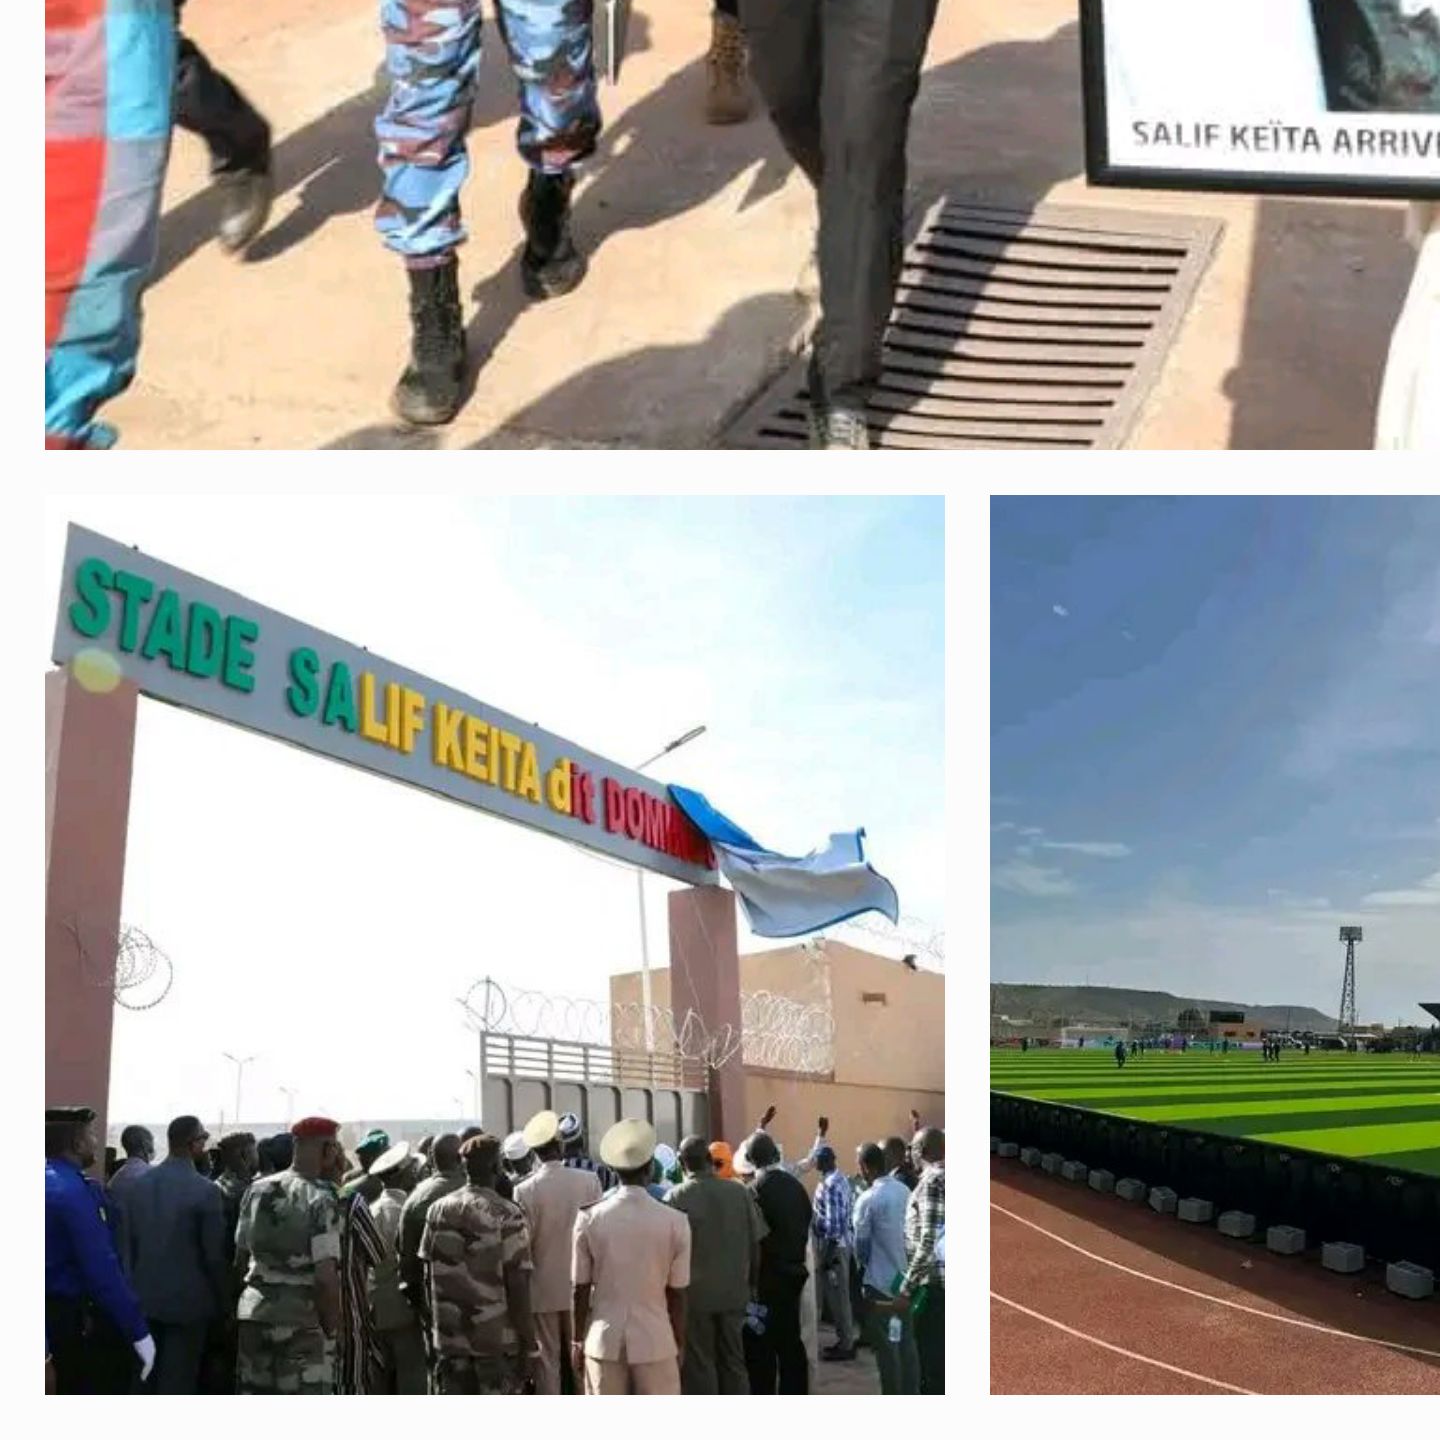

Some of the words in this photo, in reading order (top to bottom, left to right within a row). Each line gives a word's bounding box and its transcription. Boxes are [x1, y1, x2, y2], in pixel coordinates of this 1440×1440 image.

[1132, 120, 1220, 148] SALIF
[1230, 118, 1321, 153] KEÏTA
[69, 556, 258, 694] STADE
[285, 645, 426, 754] SALIF
[432, 698, 542, 804] KEITA
[545, 757, 595, 825] dit
